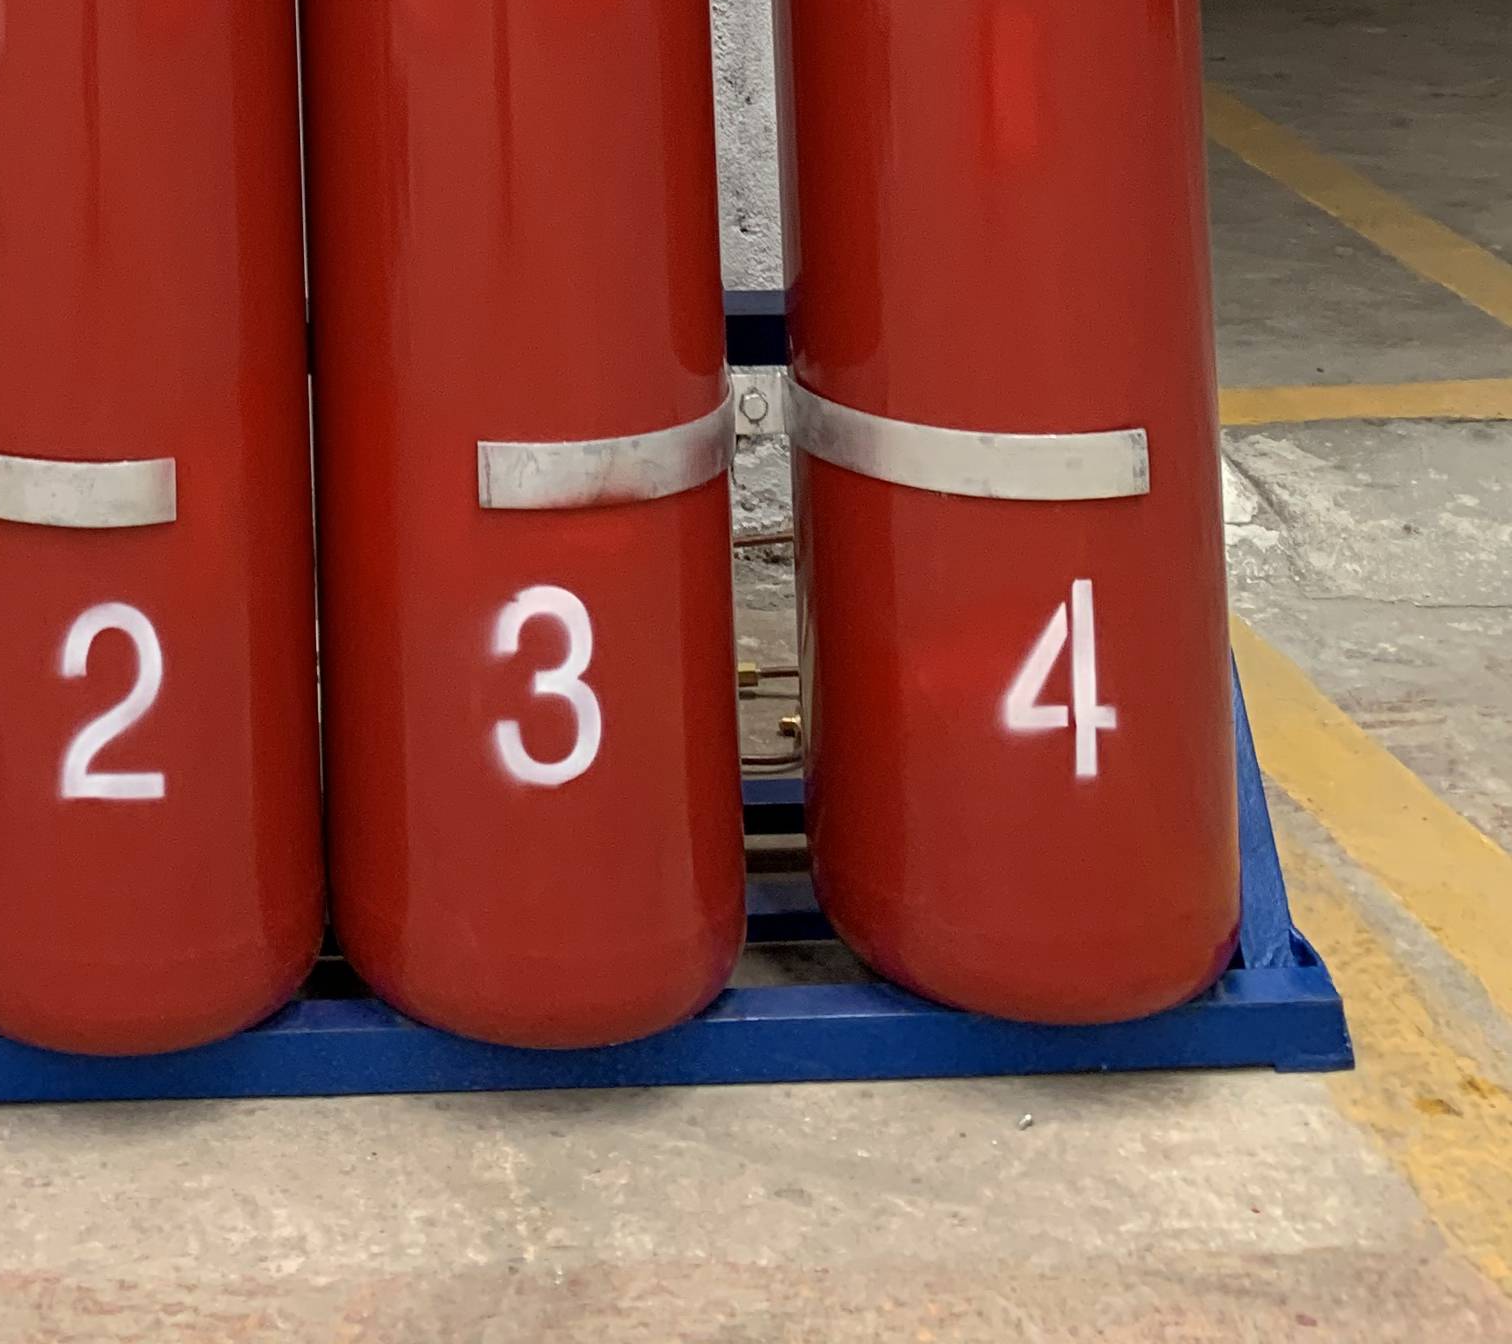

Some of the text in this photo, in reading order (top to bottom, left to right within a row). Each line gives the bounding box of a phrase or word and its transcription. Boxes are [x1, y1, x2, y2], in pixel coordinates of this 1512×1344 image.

[60, 600, 164, 801] 2
[491, 584, 602, 789] 3
[1001, 577, 1117, 778] 4
